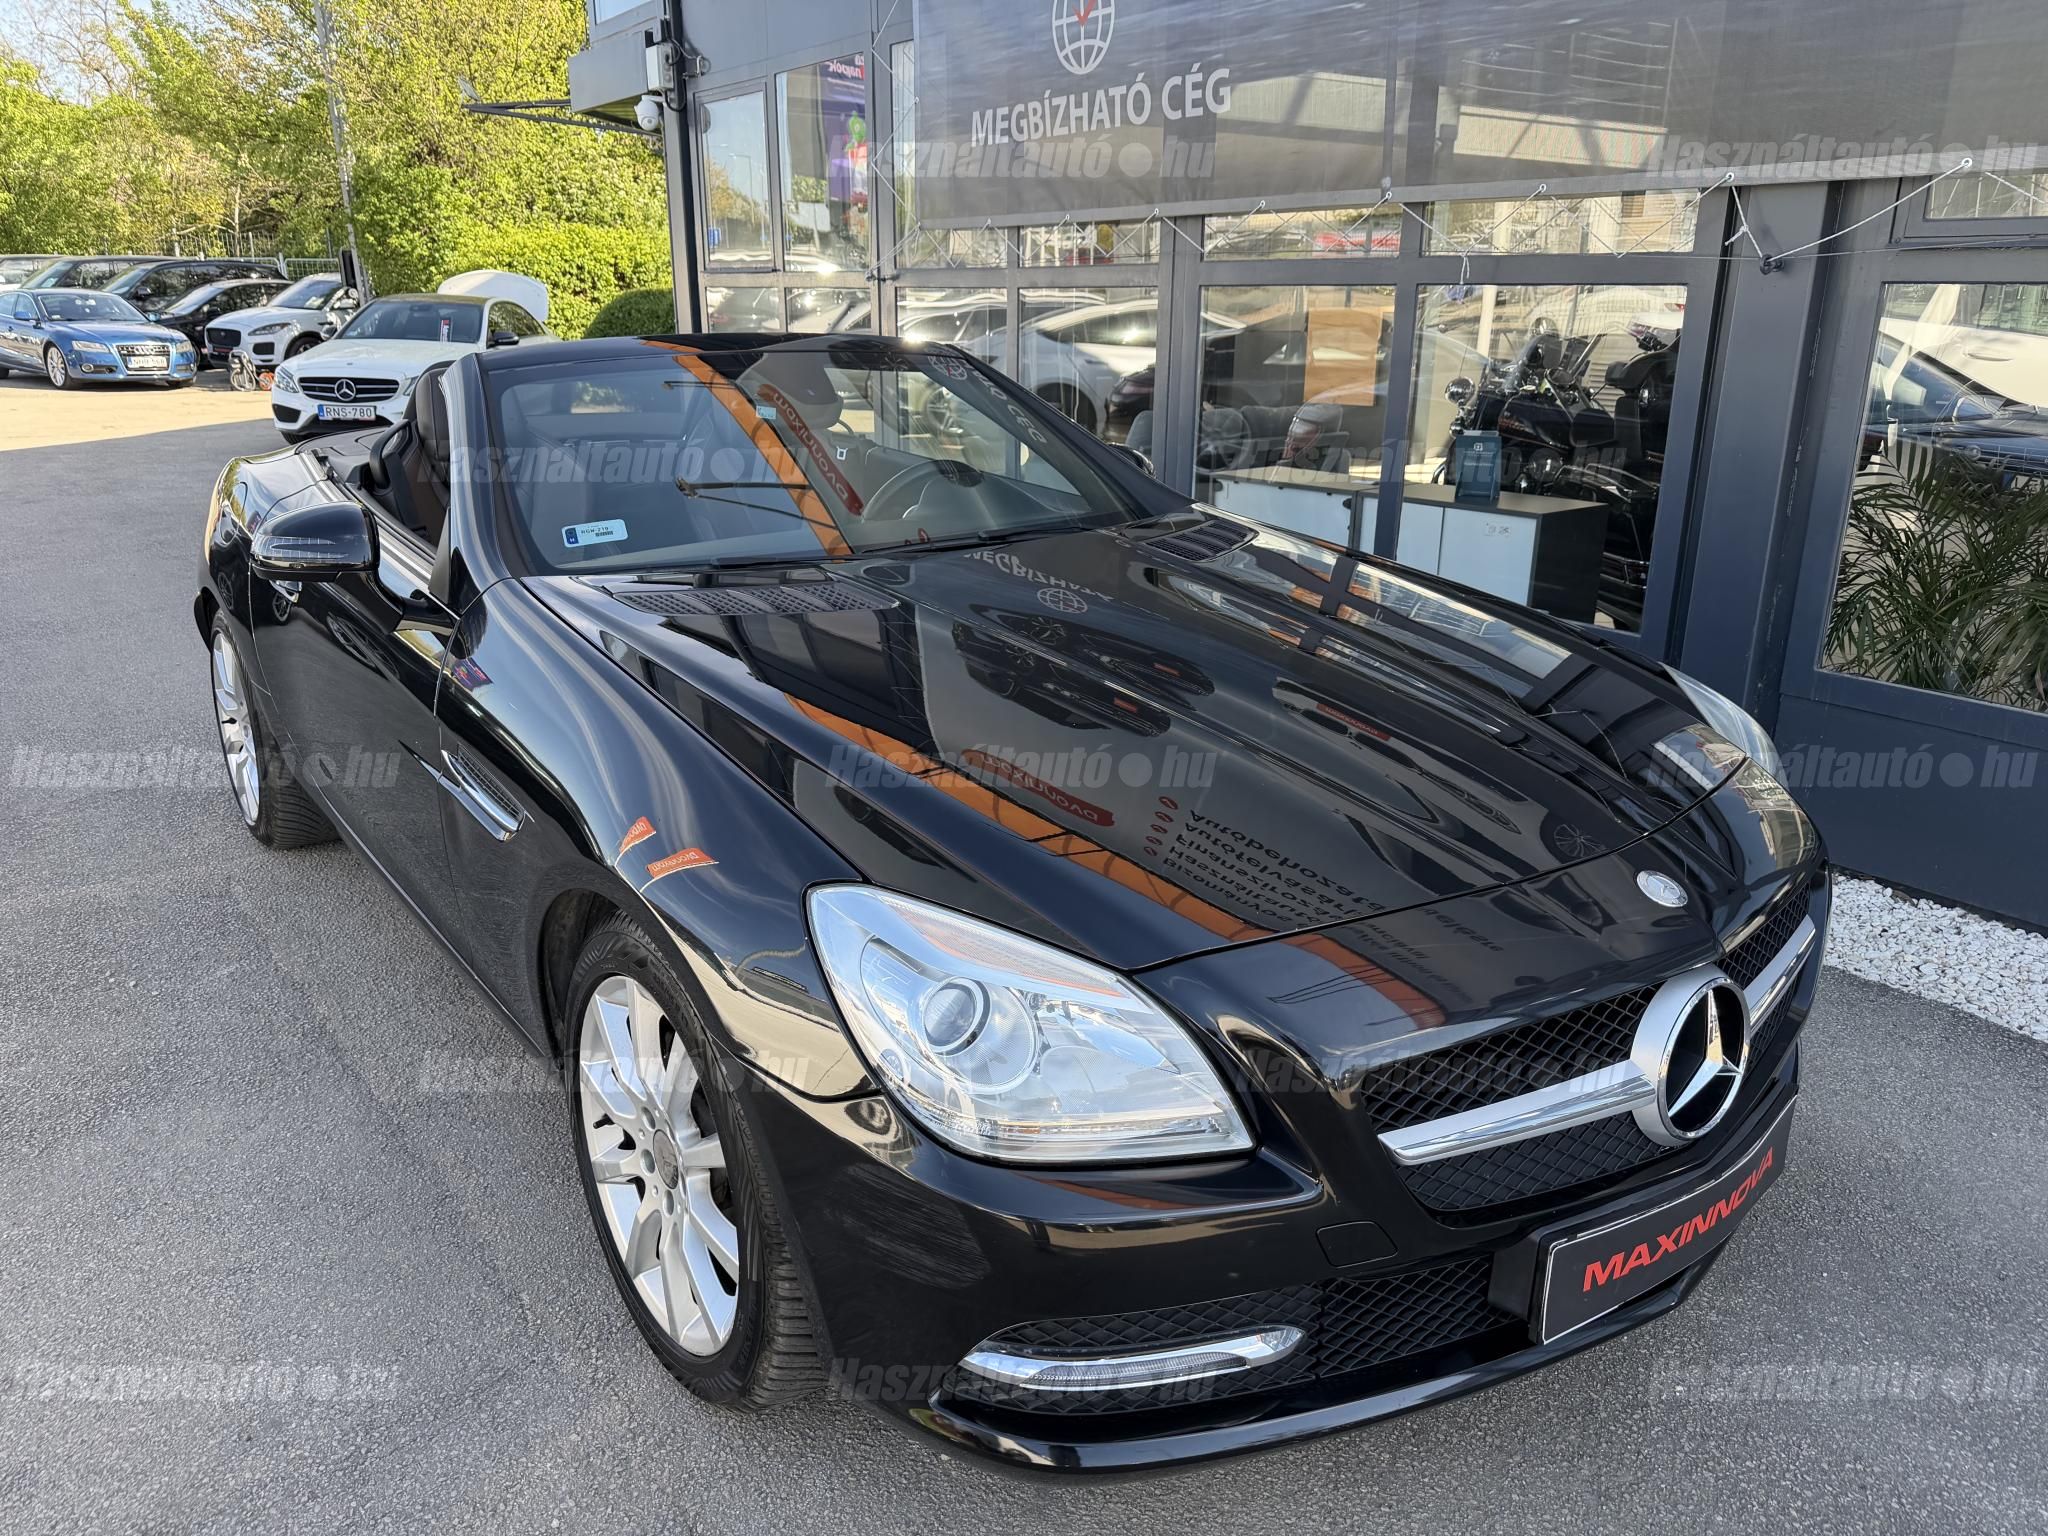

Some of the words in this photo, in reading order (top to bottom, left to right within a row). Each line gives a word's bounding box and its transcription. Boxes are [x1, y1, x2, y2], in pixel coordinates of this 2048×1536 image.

[971, 72, 1152, 148] MEGBÍZHATÓ
[1161, 63, 1232, 121] CÉG
[325, 407, 372, 418] RNS-780
[1583, 1146, 1774, 1292] MAXINNOVA
